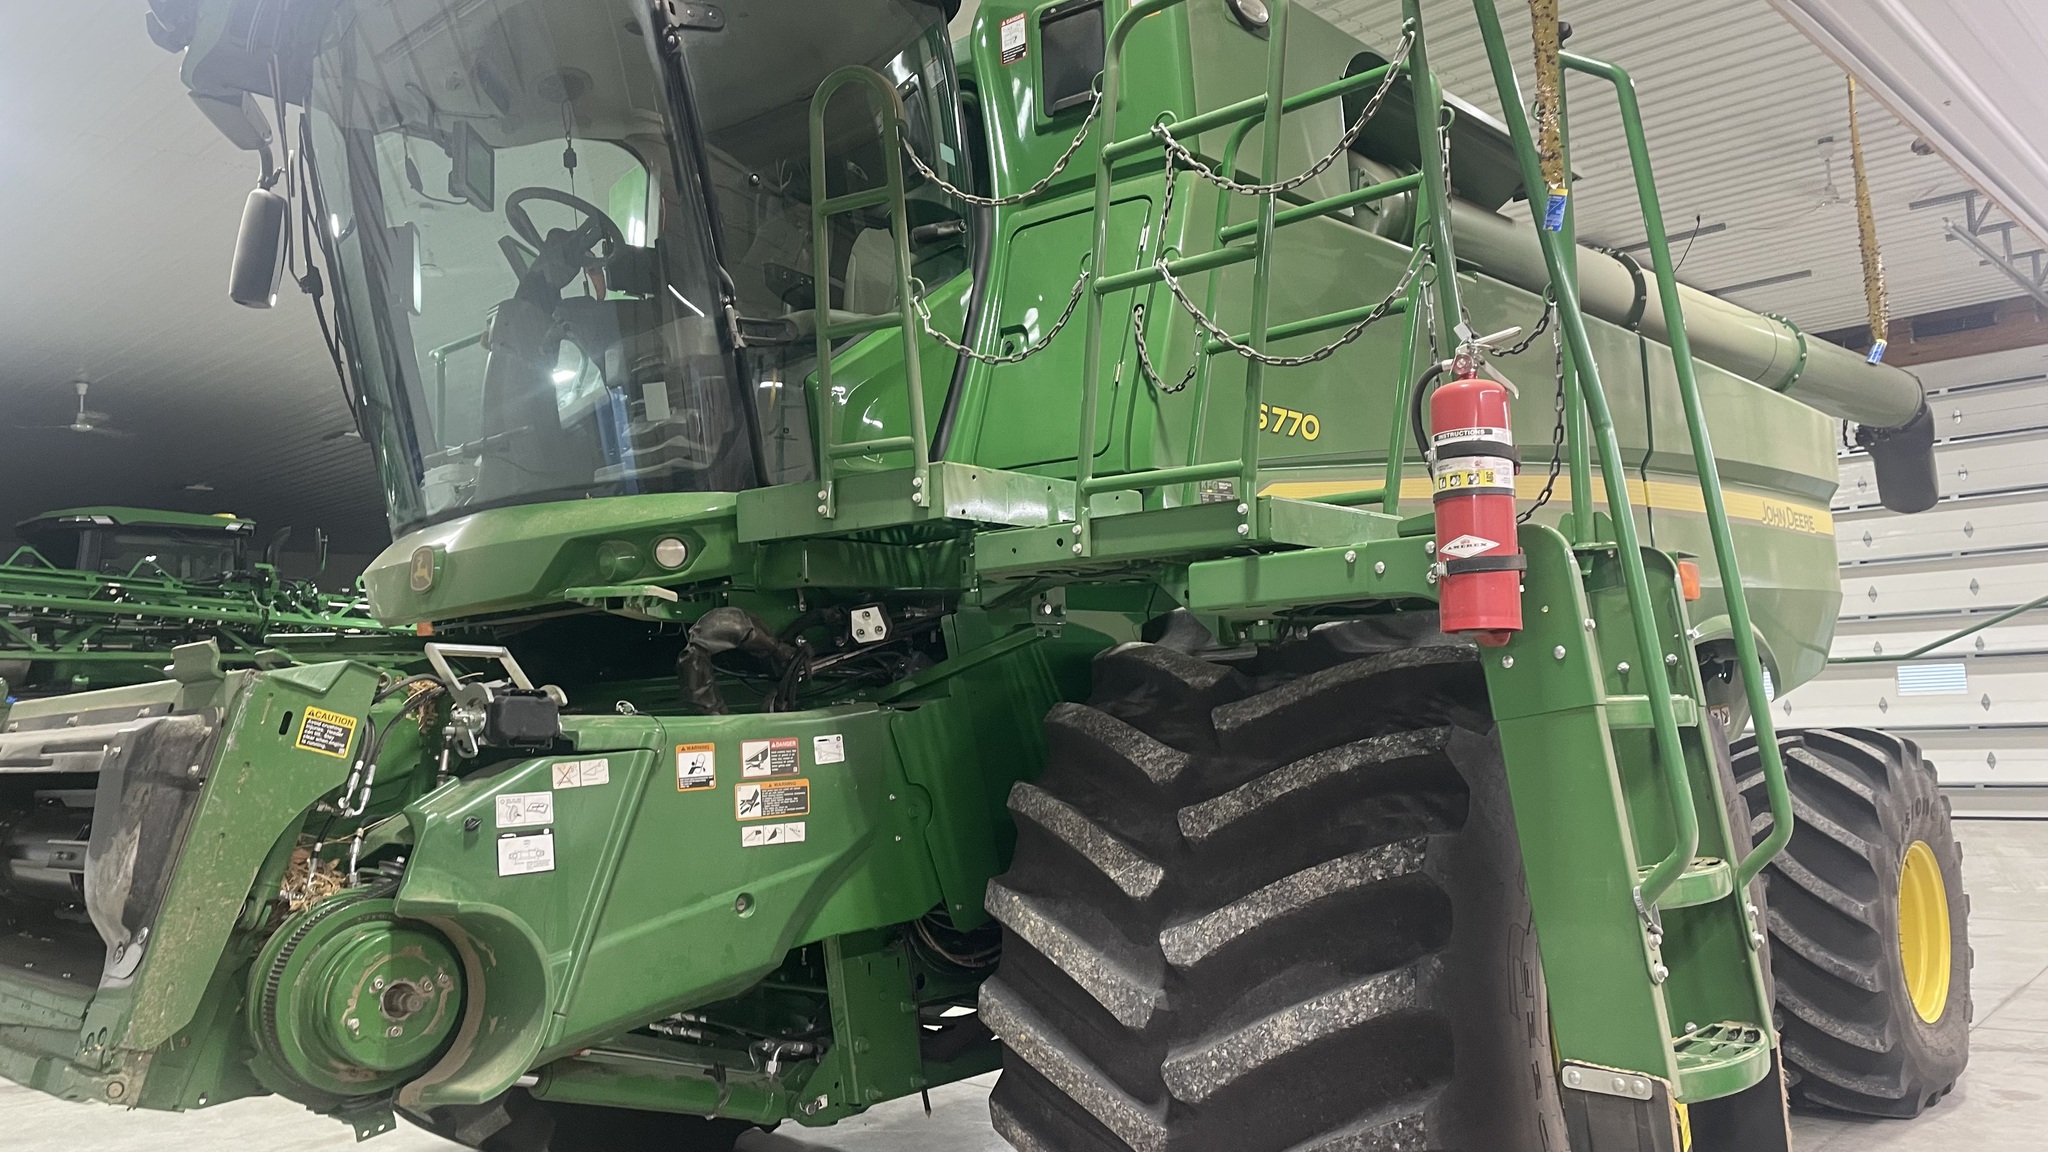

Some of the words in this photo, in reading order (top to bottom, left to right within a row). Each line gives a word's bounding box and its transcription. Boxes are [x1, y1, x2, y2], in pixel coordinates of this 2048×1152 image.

[1438, 429, 1485, 440] INSTRUCTIONS
[1762, 500, 1786, 527] JOHN
[1786, 506, 1816, 533] DEERE
[315, 710, 354, 727] CAUTION
[775, 740, 797, 748] DANGER
